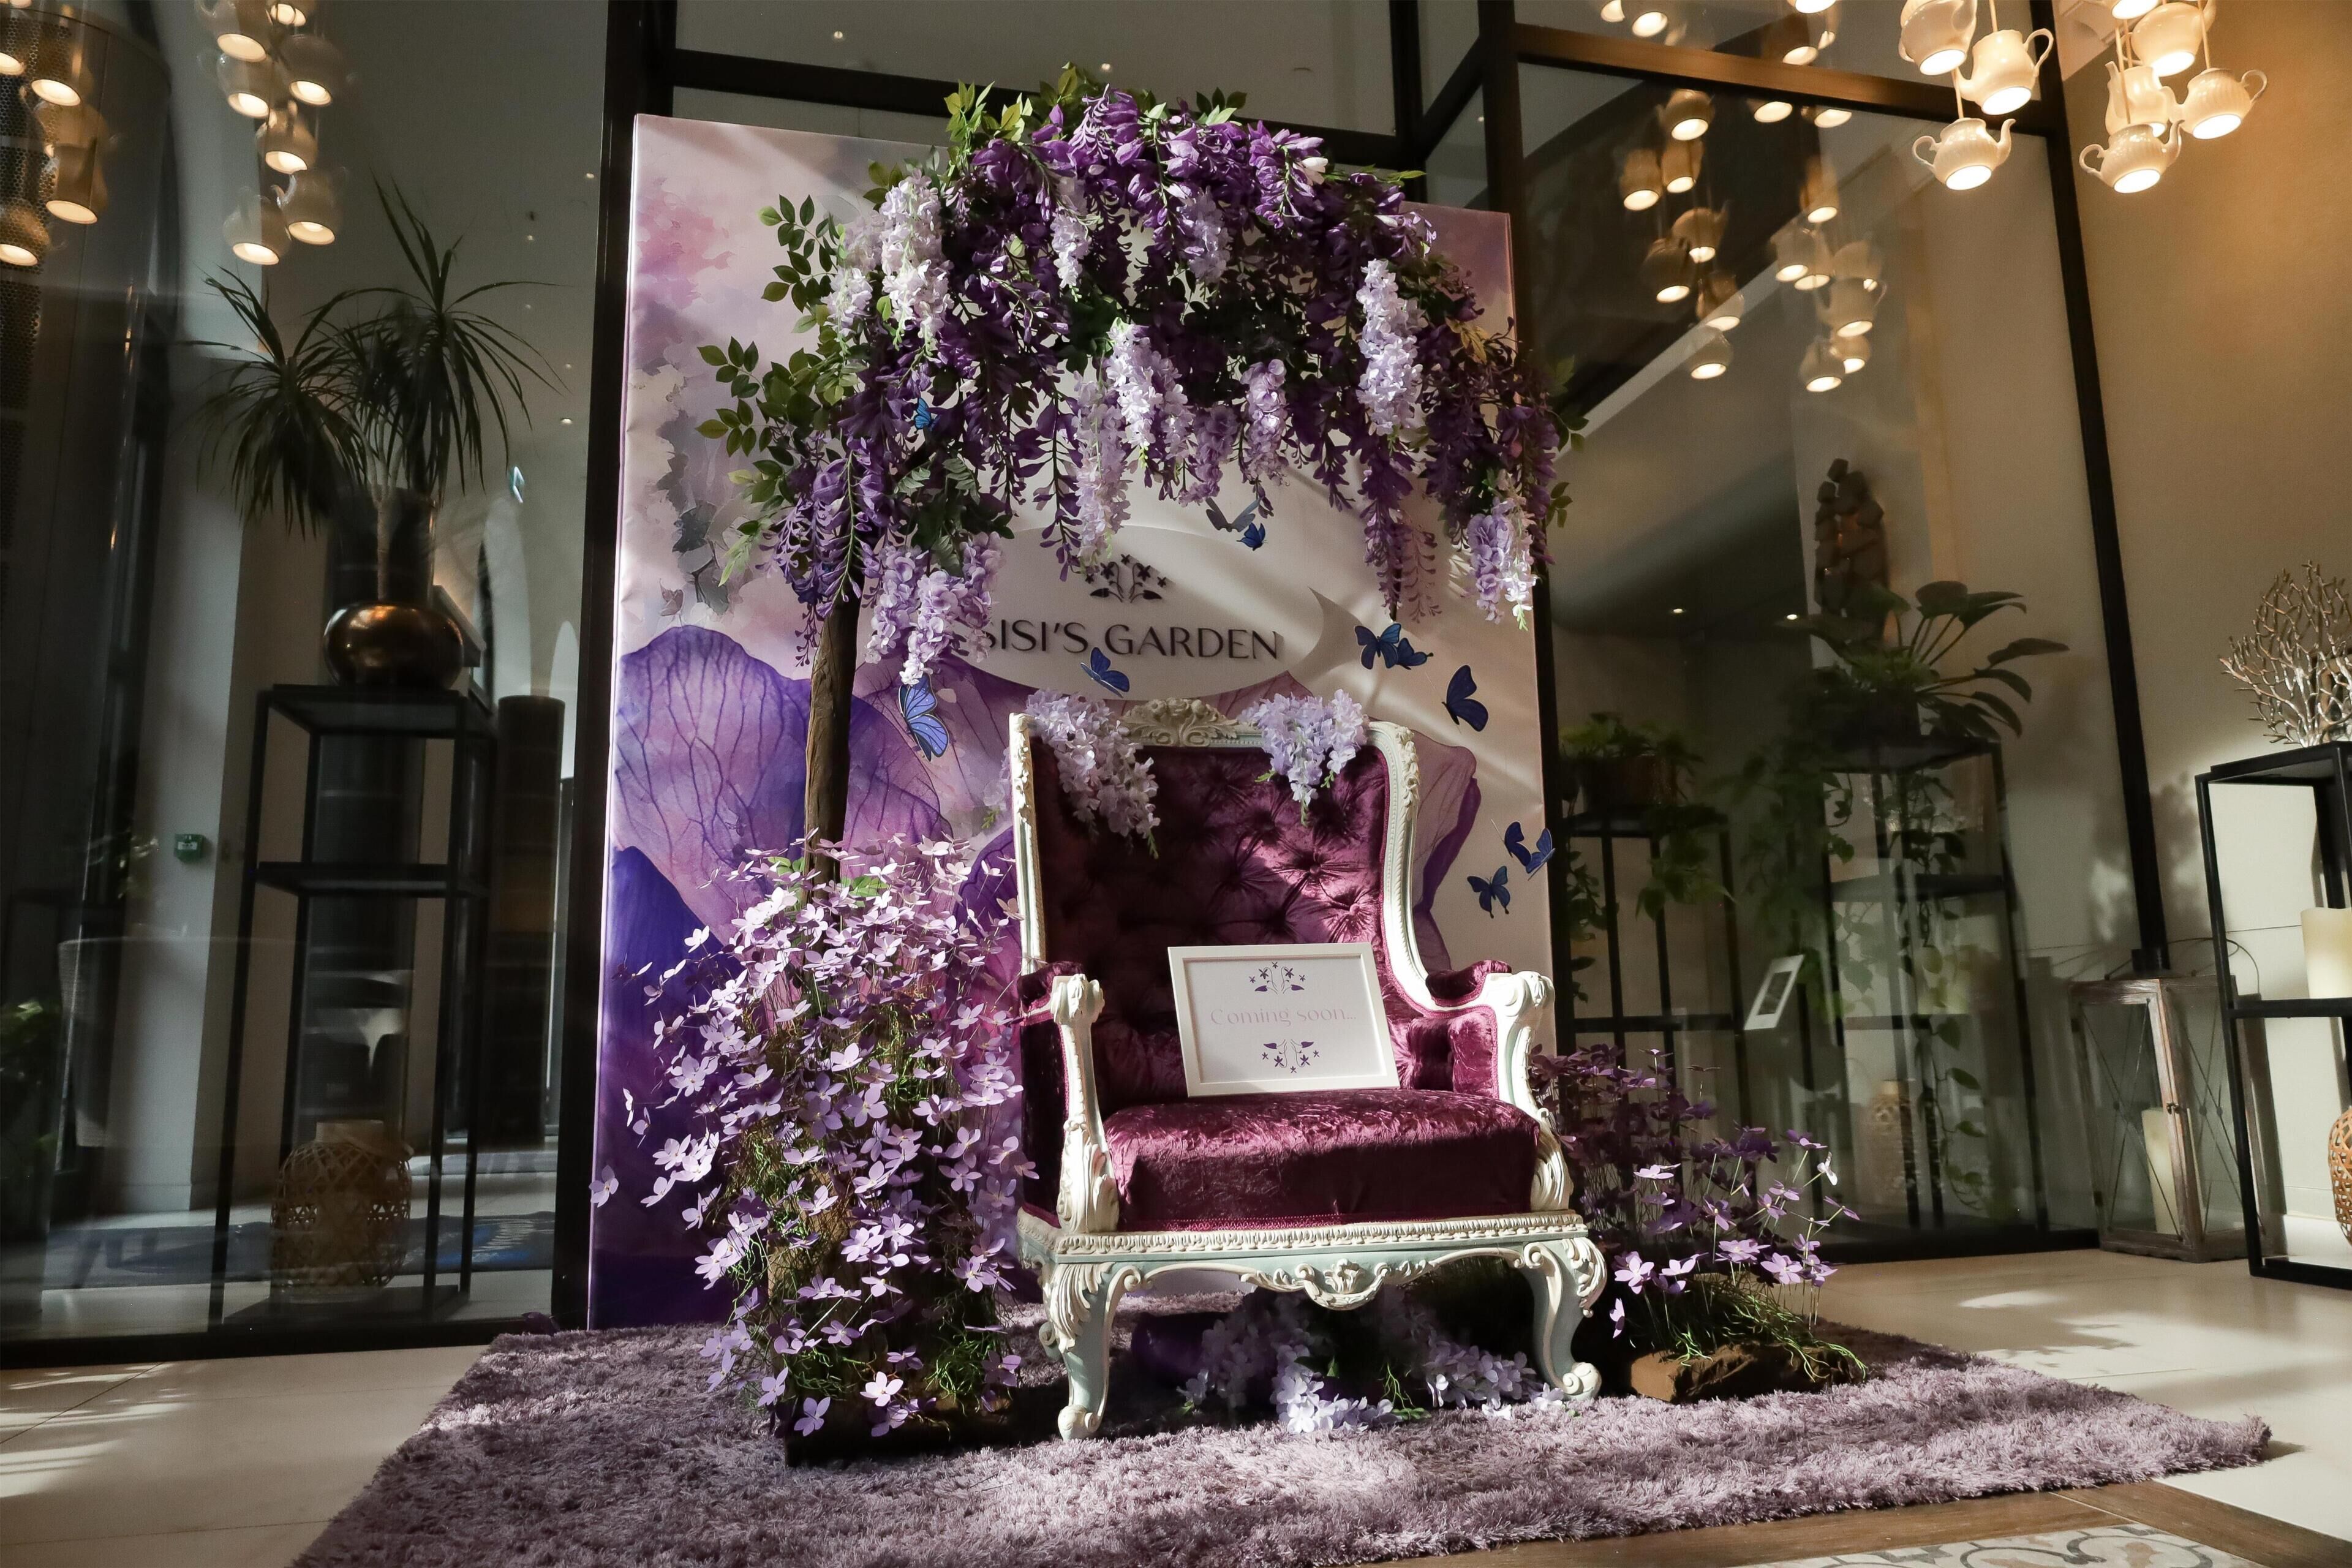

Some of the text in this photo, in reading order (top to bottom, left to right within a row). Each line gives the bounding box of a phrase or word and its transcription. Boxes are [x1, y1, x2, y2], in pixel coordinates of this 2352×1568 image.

[1104, 624, 1278, 660] GARDEN
[1210, 1008, 1357, 1027] Coming soon...
